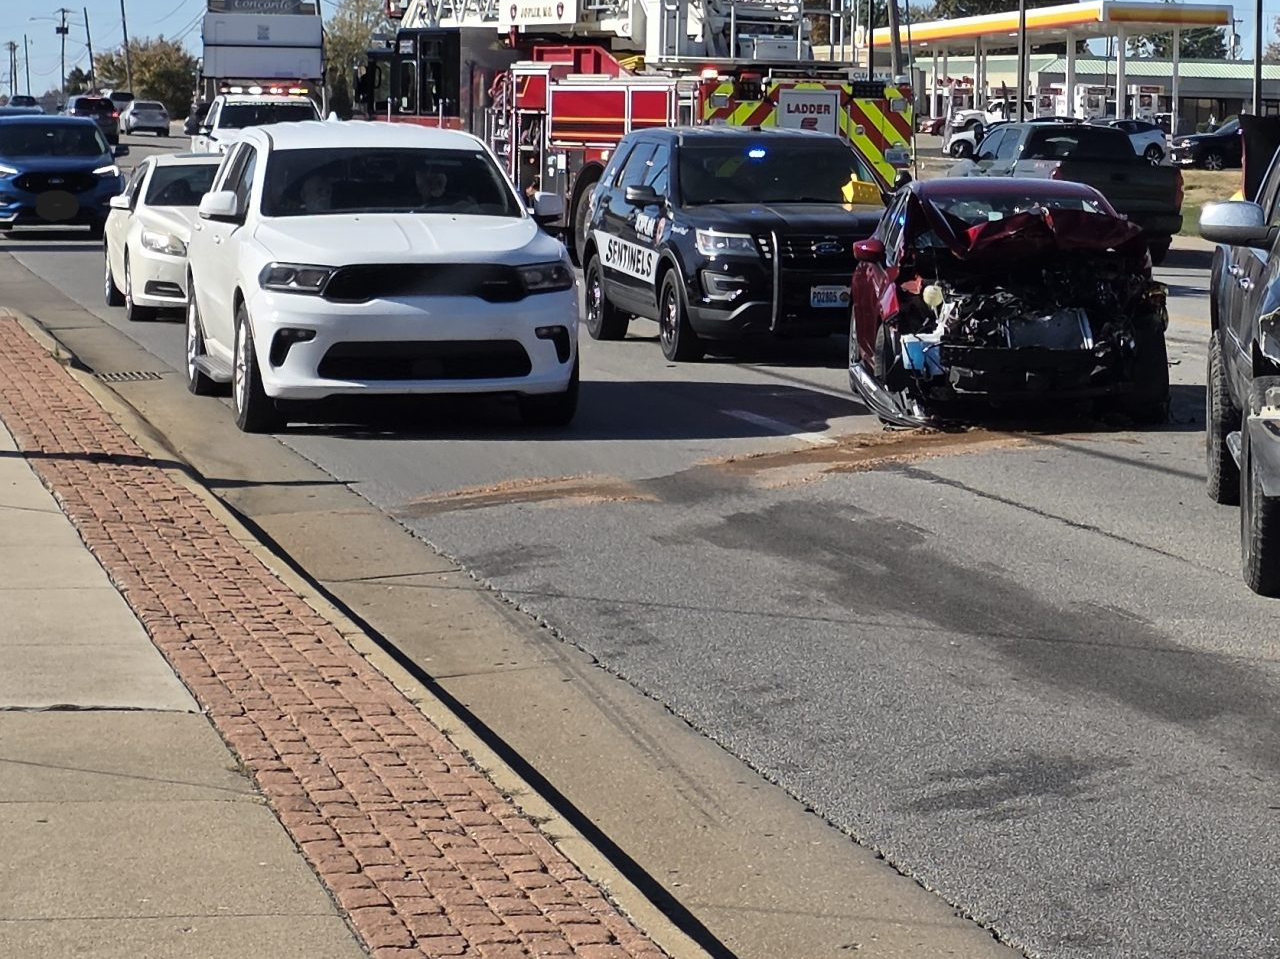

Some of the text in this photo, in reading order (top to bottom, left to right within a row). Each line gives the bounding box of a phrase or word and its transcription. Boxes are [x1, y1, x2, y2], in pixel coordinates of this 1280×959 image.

[233, 0, 291, 10] Concorde
[787, 103, 831, 115] LADDER
[635, 213, 656, 237] JOPLIN
[605, 238, 653, 277] SENTINELS
